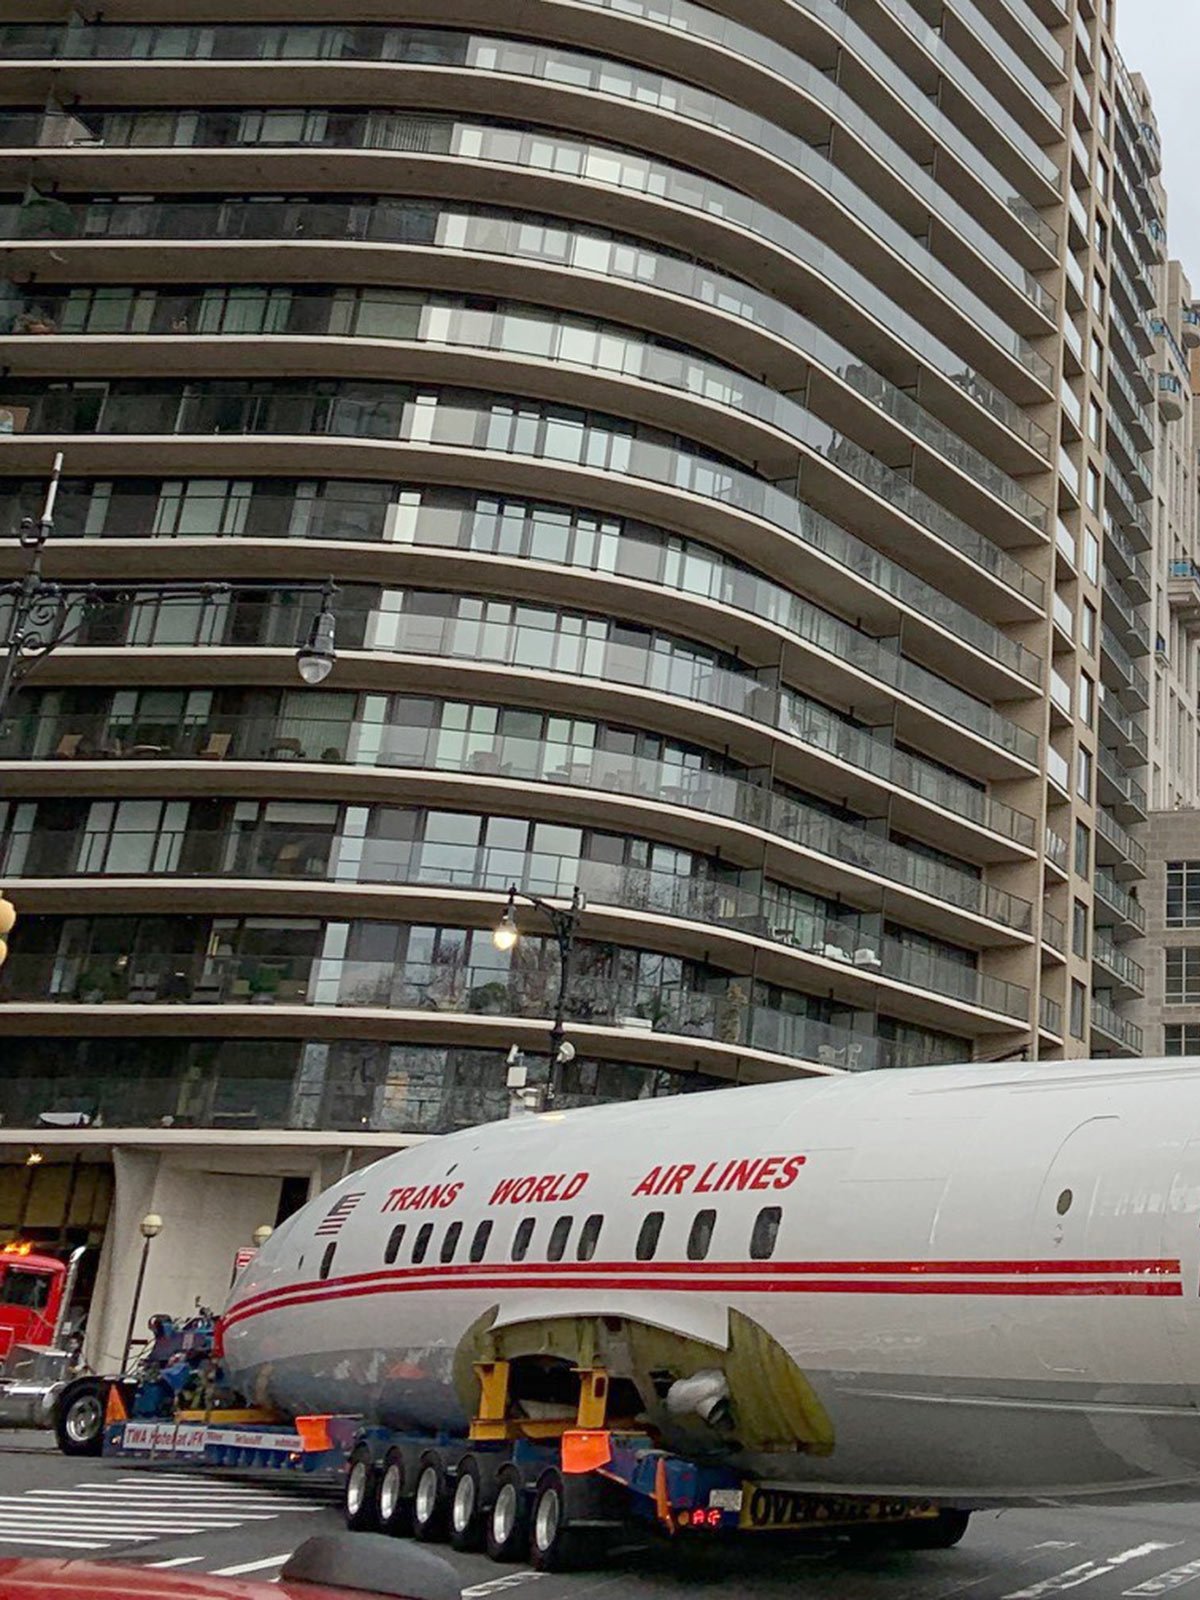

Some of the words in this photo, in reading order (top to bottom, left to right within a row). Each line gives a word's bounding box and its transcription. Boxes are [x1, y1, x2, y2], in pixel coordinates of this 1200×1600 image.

[381, 1182, 464, 1213] TRANS
[488, 1172, 589, 1206] WORLD
[632, 1164, 696, 1196] AIR
[692, 1156, 806, 1194] LINES
[127, 1428, 147, 1443] TWA
